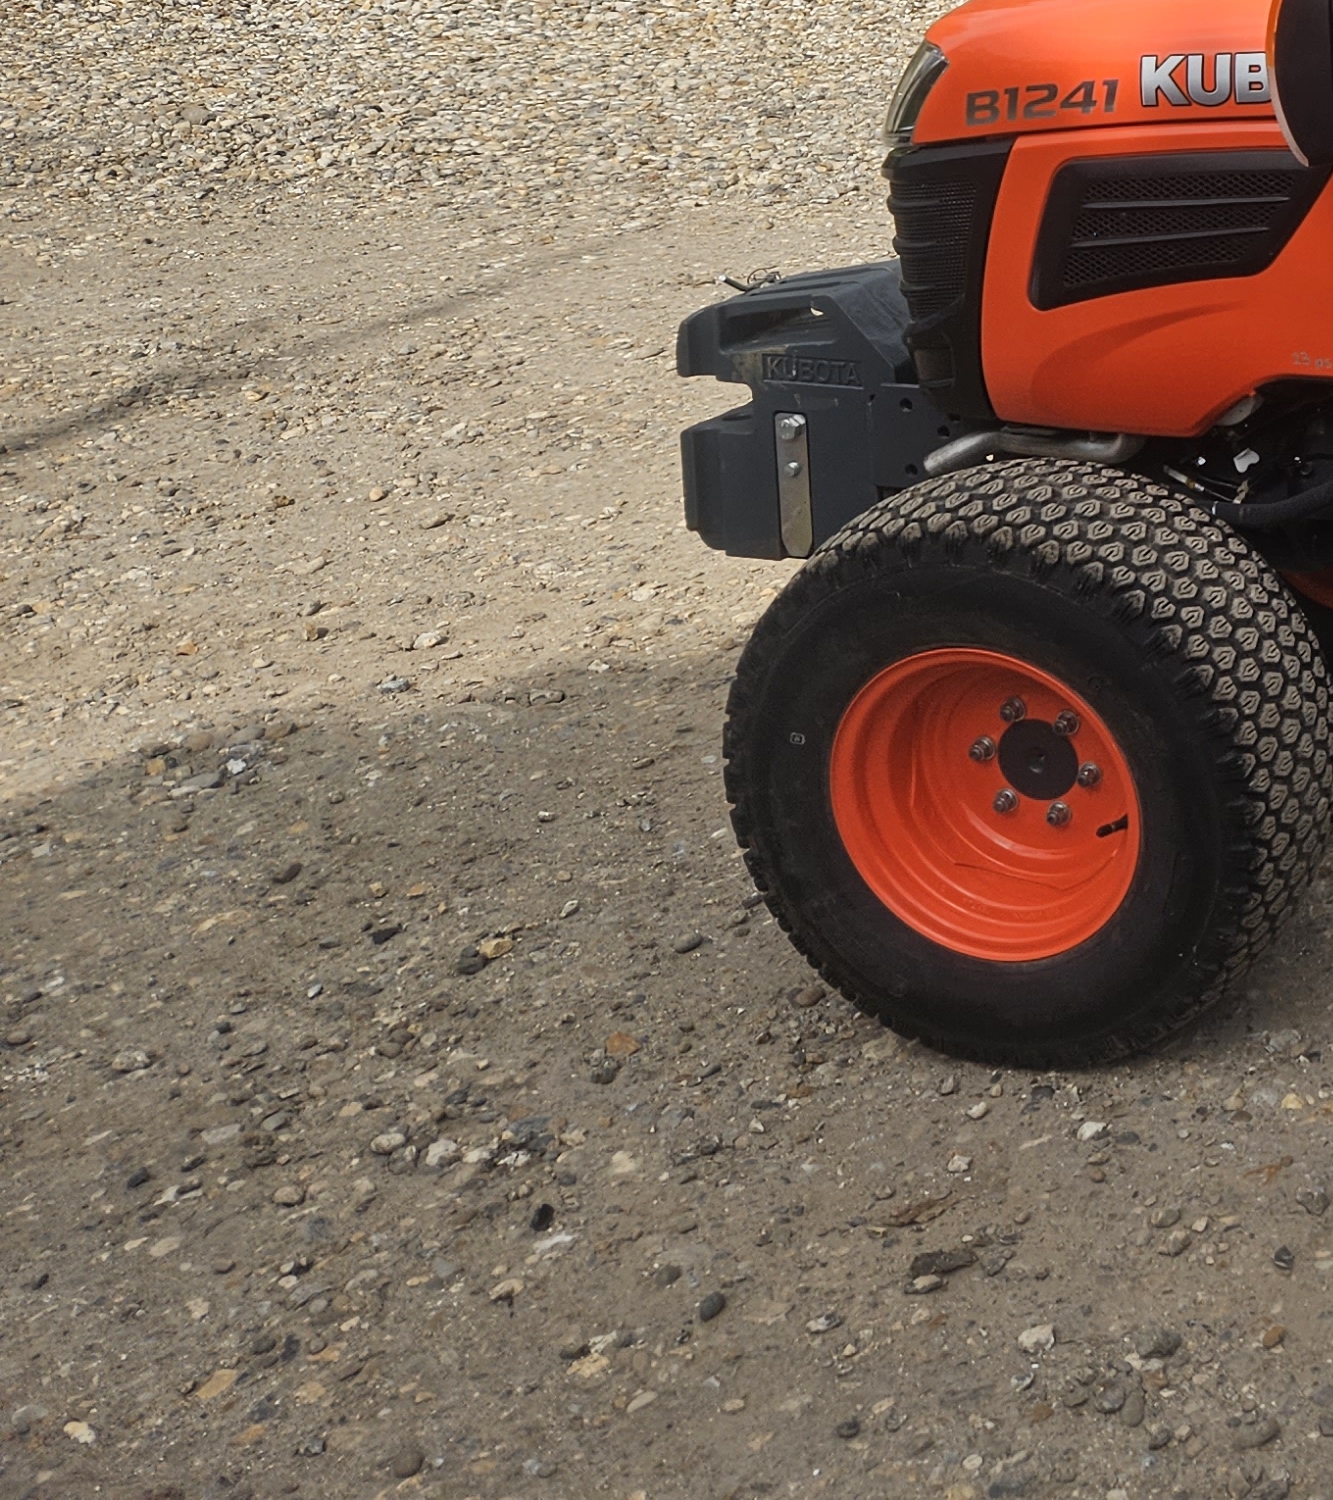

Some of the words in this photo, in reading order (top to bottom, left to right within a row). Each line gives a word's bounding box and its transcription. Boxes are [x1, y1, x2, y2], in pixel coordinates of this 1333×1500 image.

[965, 78, 1119, 127] B1241
[1139, 51, 1272, 107] KUB
[766, 356, 862, 385] KUBOTA
